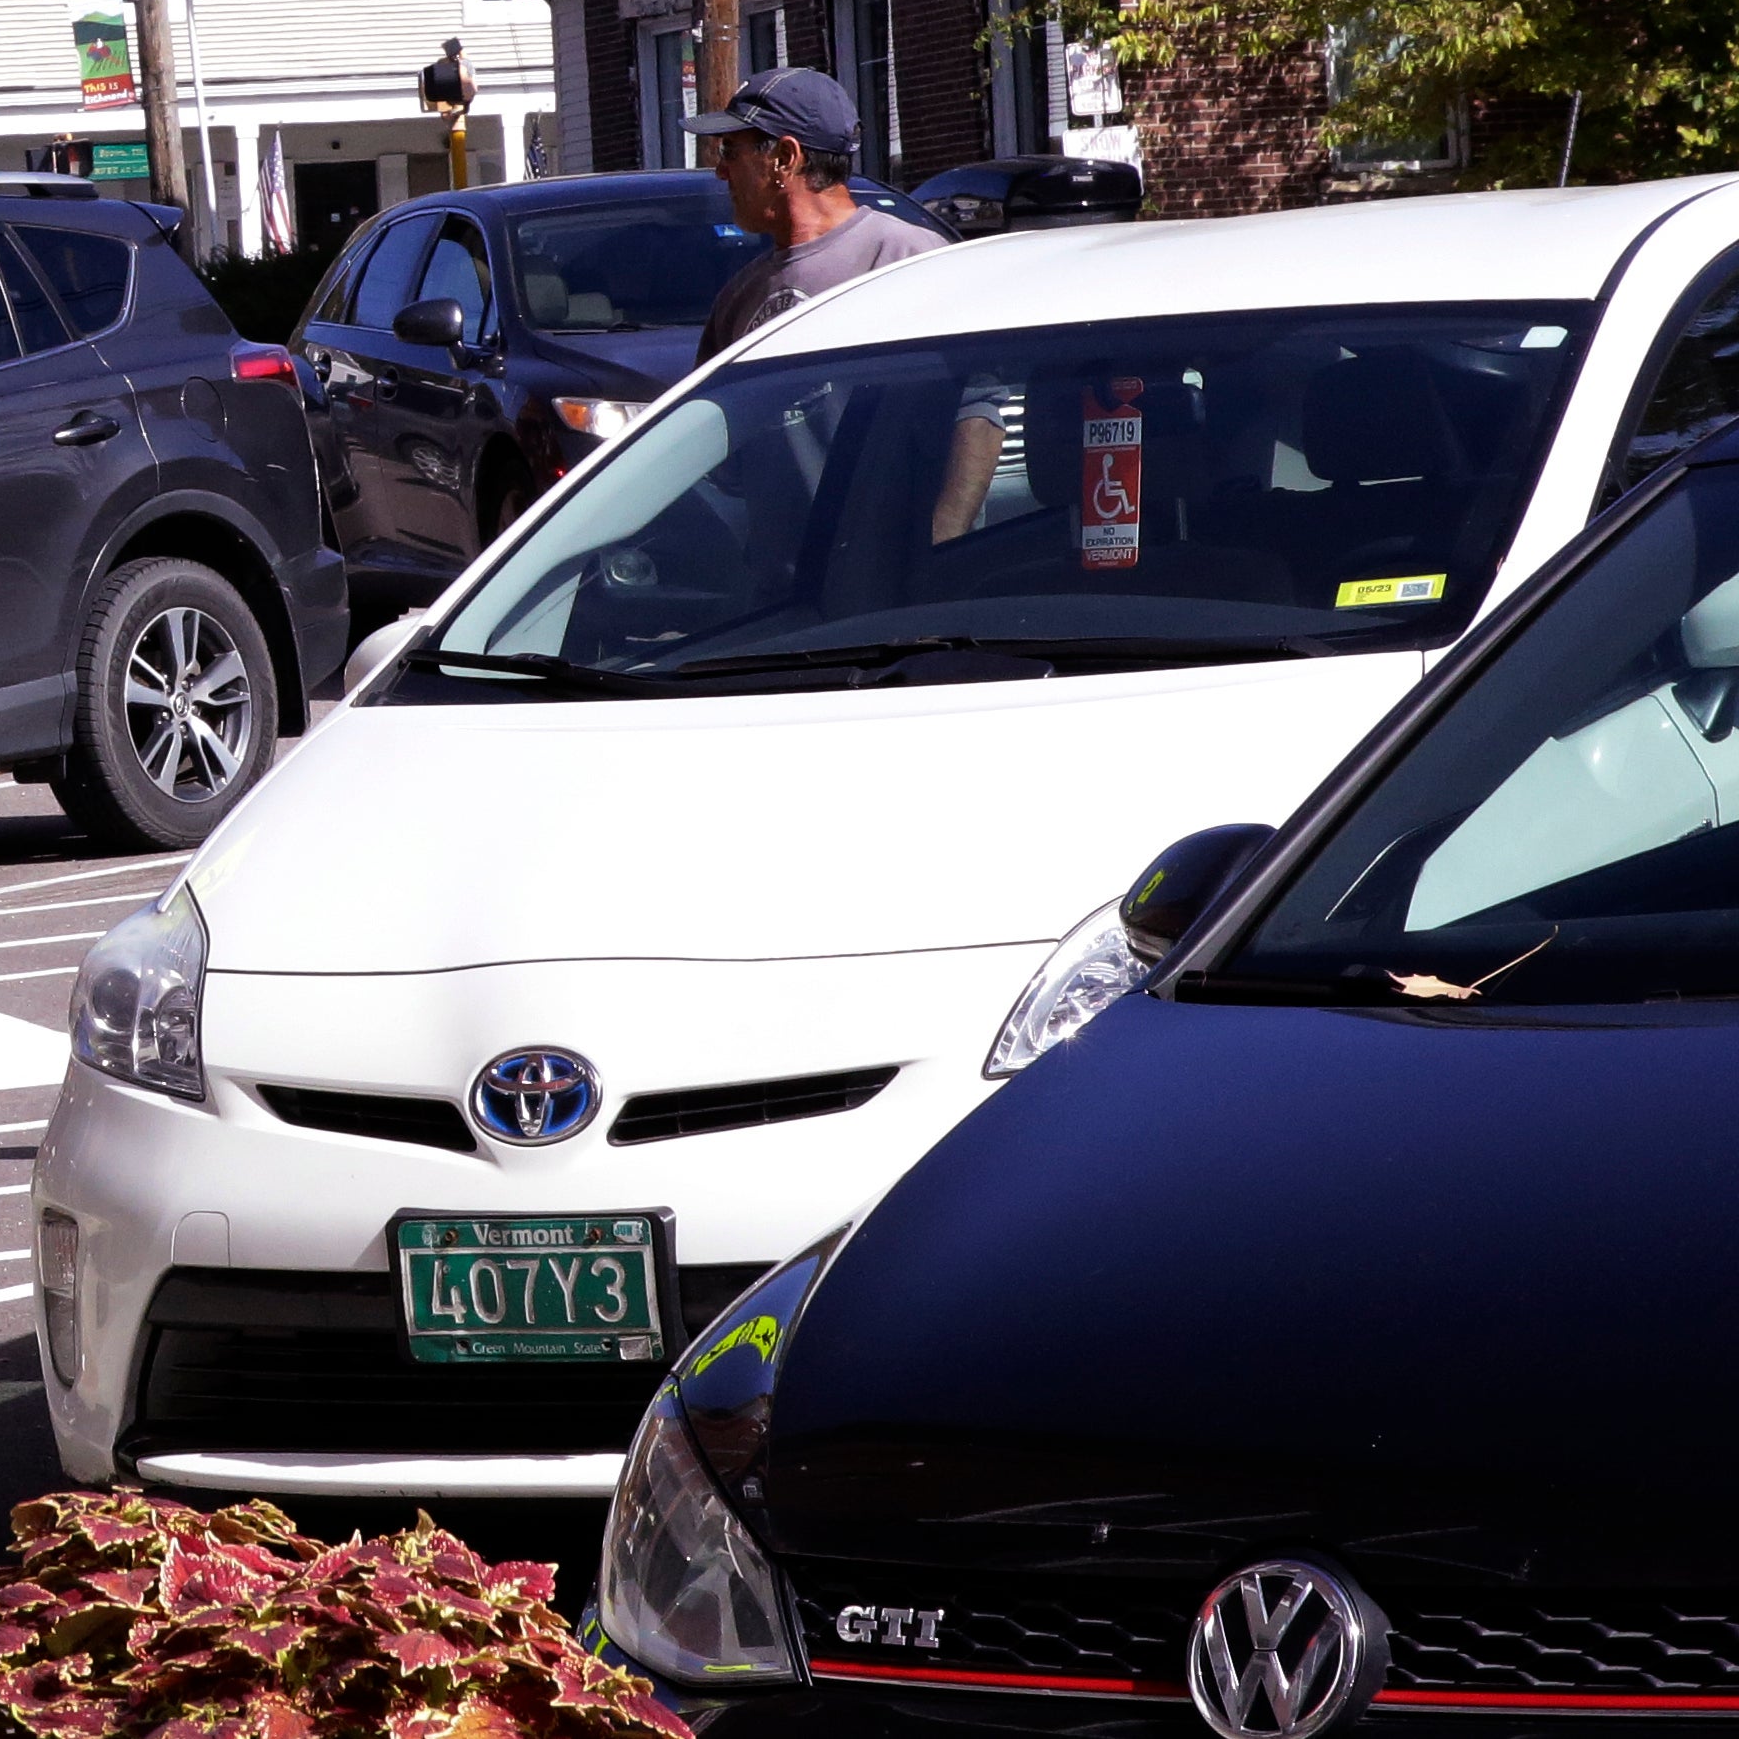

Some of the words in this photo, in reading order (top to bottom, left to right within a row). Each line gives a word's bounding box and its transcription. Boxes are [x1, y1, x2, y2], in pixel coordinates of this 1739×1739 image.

[1089, 420, 1135, 444] P96719
[1102, 526, 1115, 536] NO
[1085, 536, 1134, 548] EXPIRATION
[1086, 548, 1133, 561] VERMONT
[473, 1223, 574, 1246] Vermont
[431, 1256, 628, 1324] 407Y3
[472, 1342, 506, 1356] Green
[513, 1342, 566, 1355] Mountain
[574, 1341, 602, 1355] State
[836, 1604, 944, 1650] GTI
